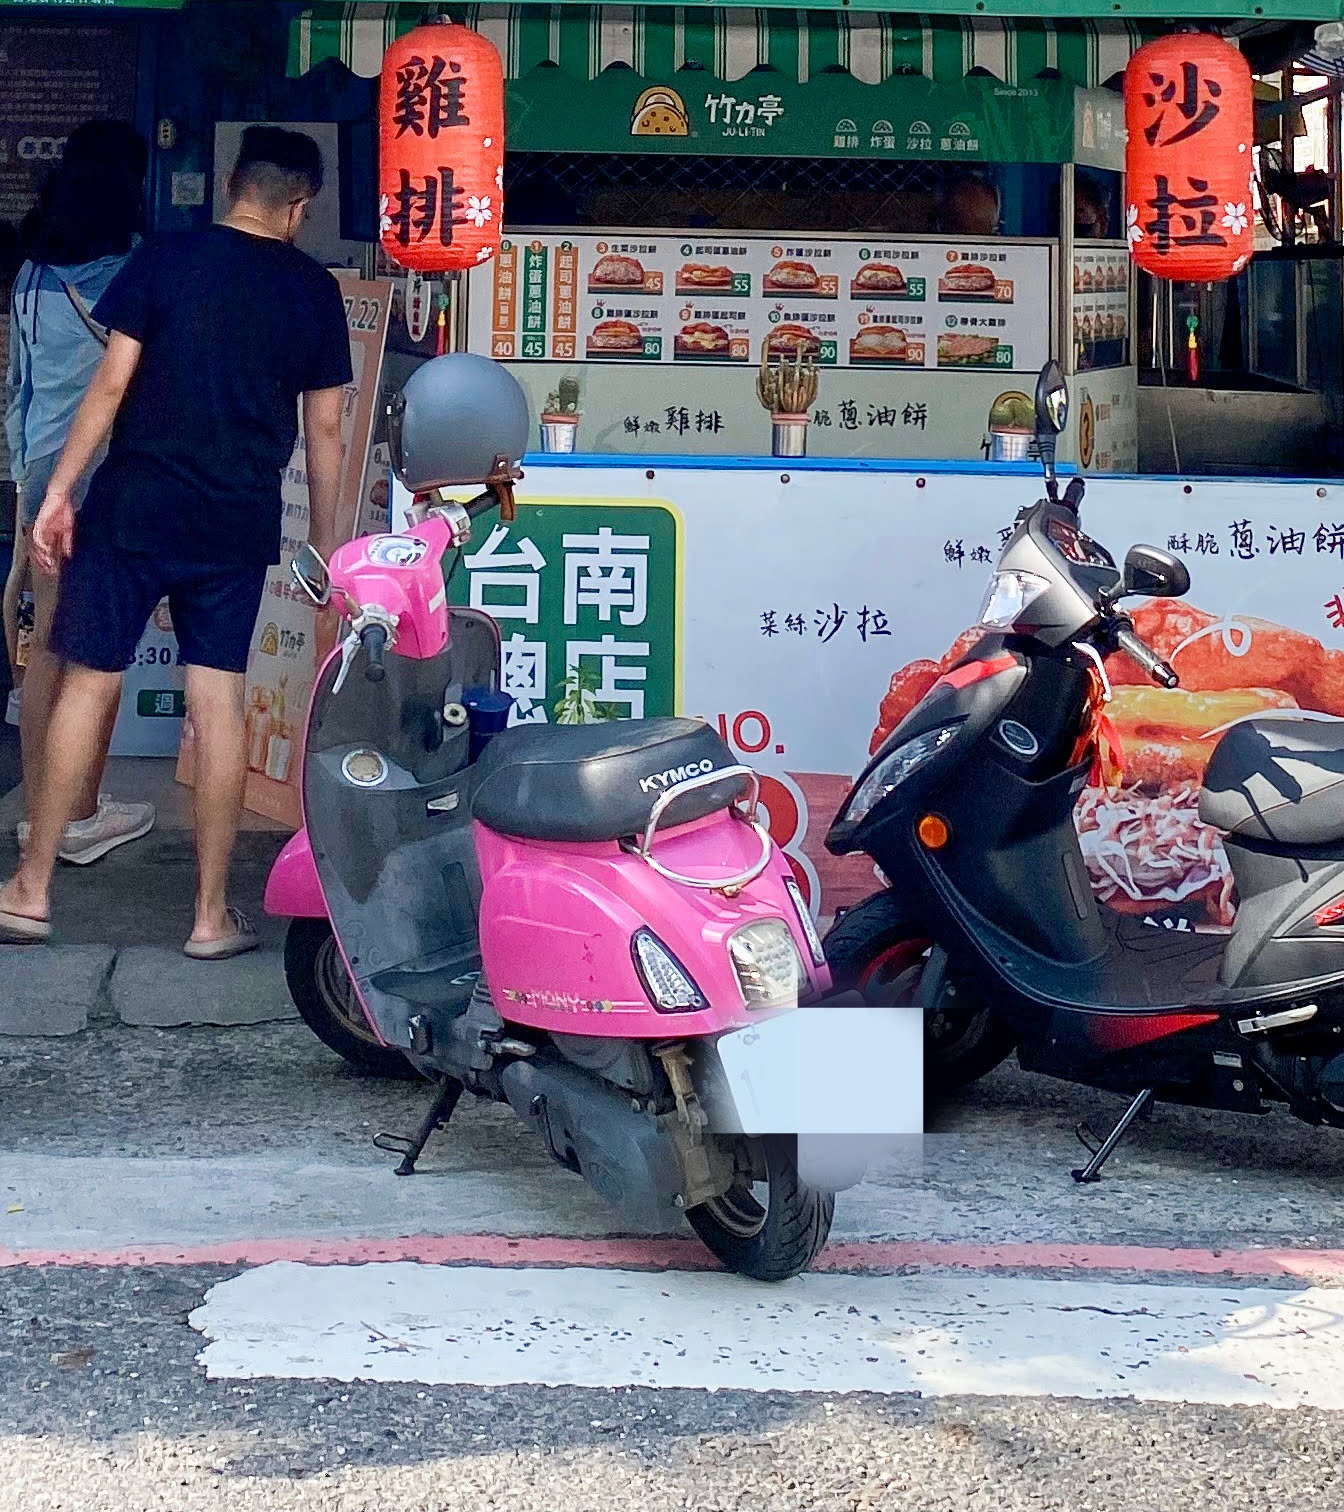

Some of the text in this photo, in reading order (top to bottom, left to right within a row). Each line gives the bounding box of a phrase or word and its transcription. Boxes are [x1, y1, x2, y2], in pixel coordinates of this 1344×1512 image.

[704, 94, 785, 126] 竹力亭
[870, 136, 896, 150] 炸蛋
[906, 137, 933, 151] 沙拉
[393, 55, 470, 248] 雞排
[1142, 60, 1228, 257] 沙拉
[645, 277, 661, 289] 45
[734, 280, 749, 292] 55
[821, 282, 836, 294] 55
[908, 284, 924, 296] 55
[997, 286, 1012, 299] 70
[494, 342, 513, 356] 40
[524, 342, 543, 356] 45
[555, 342, 573, 357] 45
[644, 343, 660, 355] 80
[731, 344, 747, 357] 80
[819, 346, 836, 359] 90
[907, 349, 923, 361] 90
[996, 352, 1011, 364] 80
[806, 398, 928, 431] 脆蔥油餅
[464, 523, 650, 626] 台南
[639, 759, 714, 793] KYMCO
